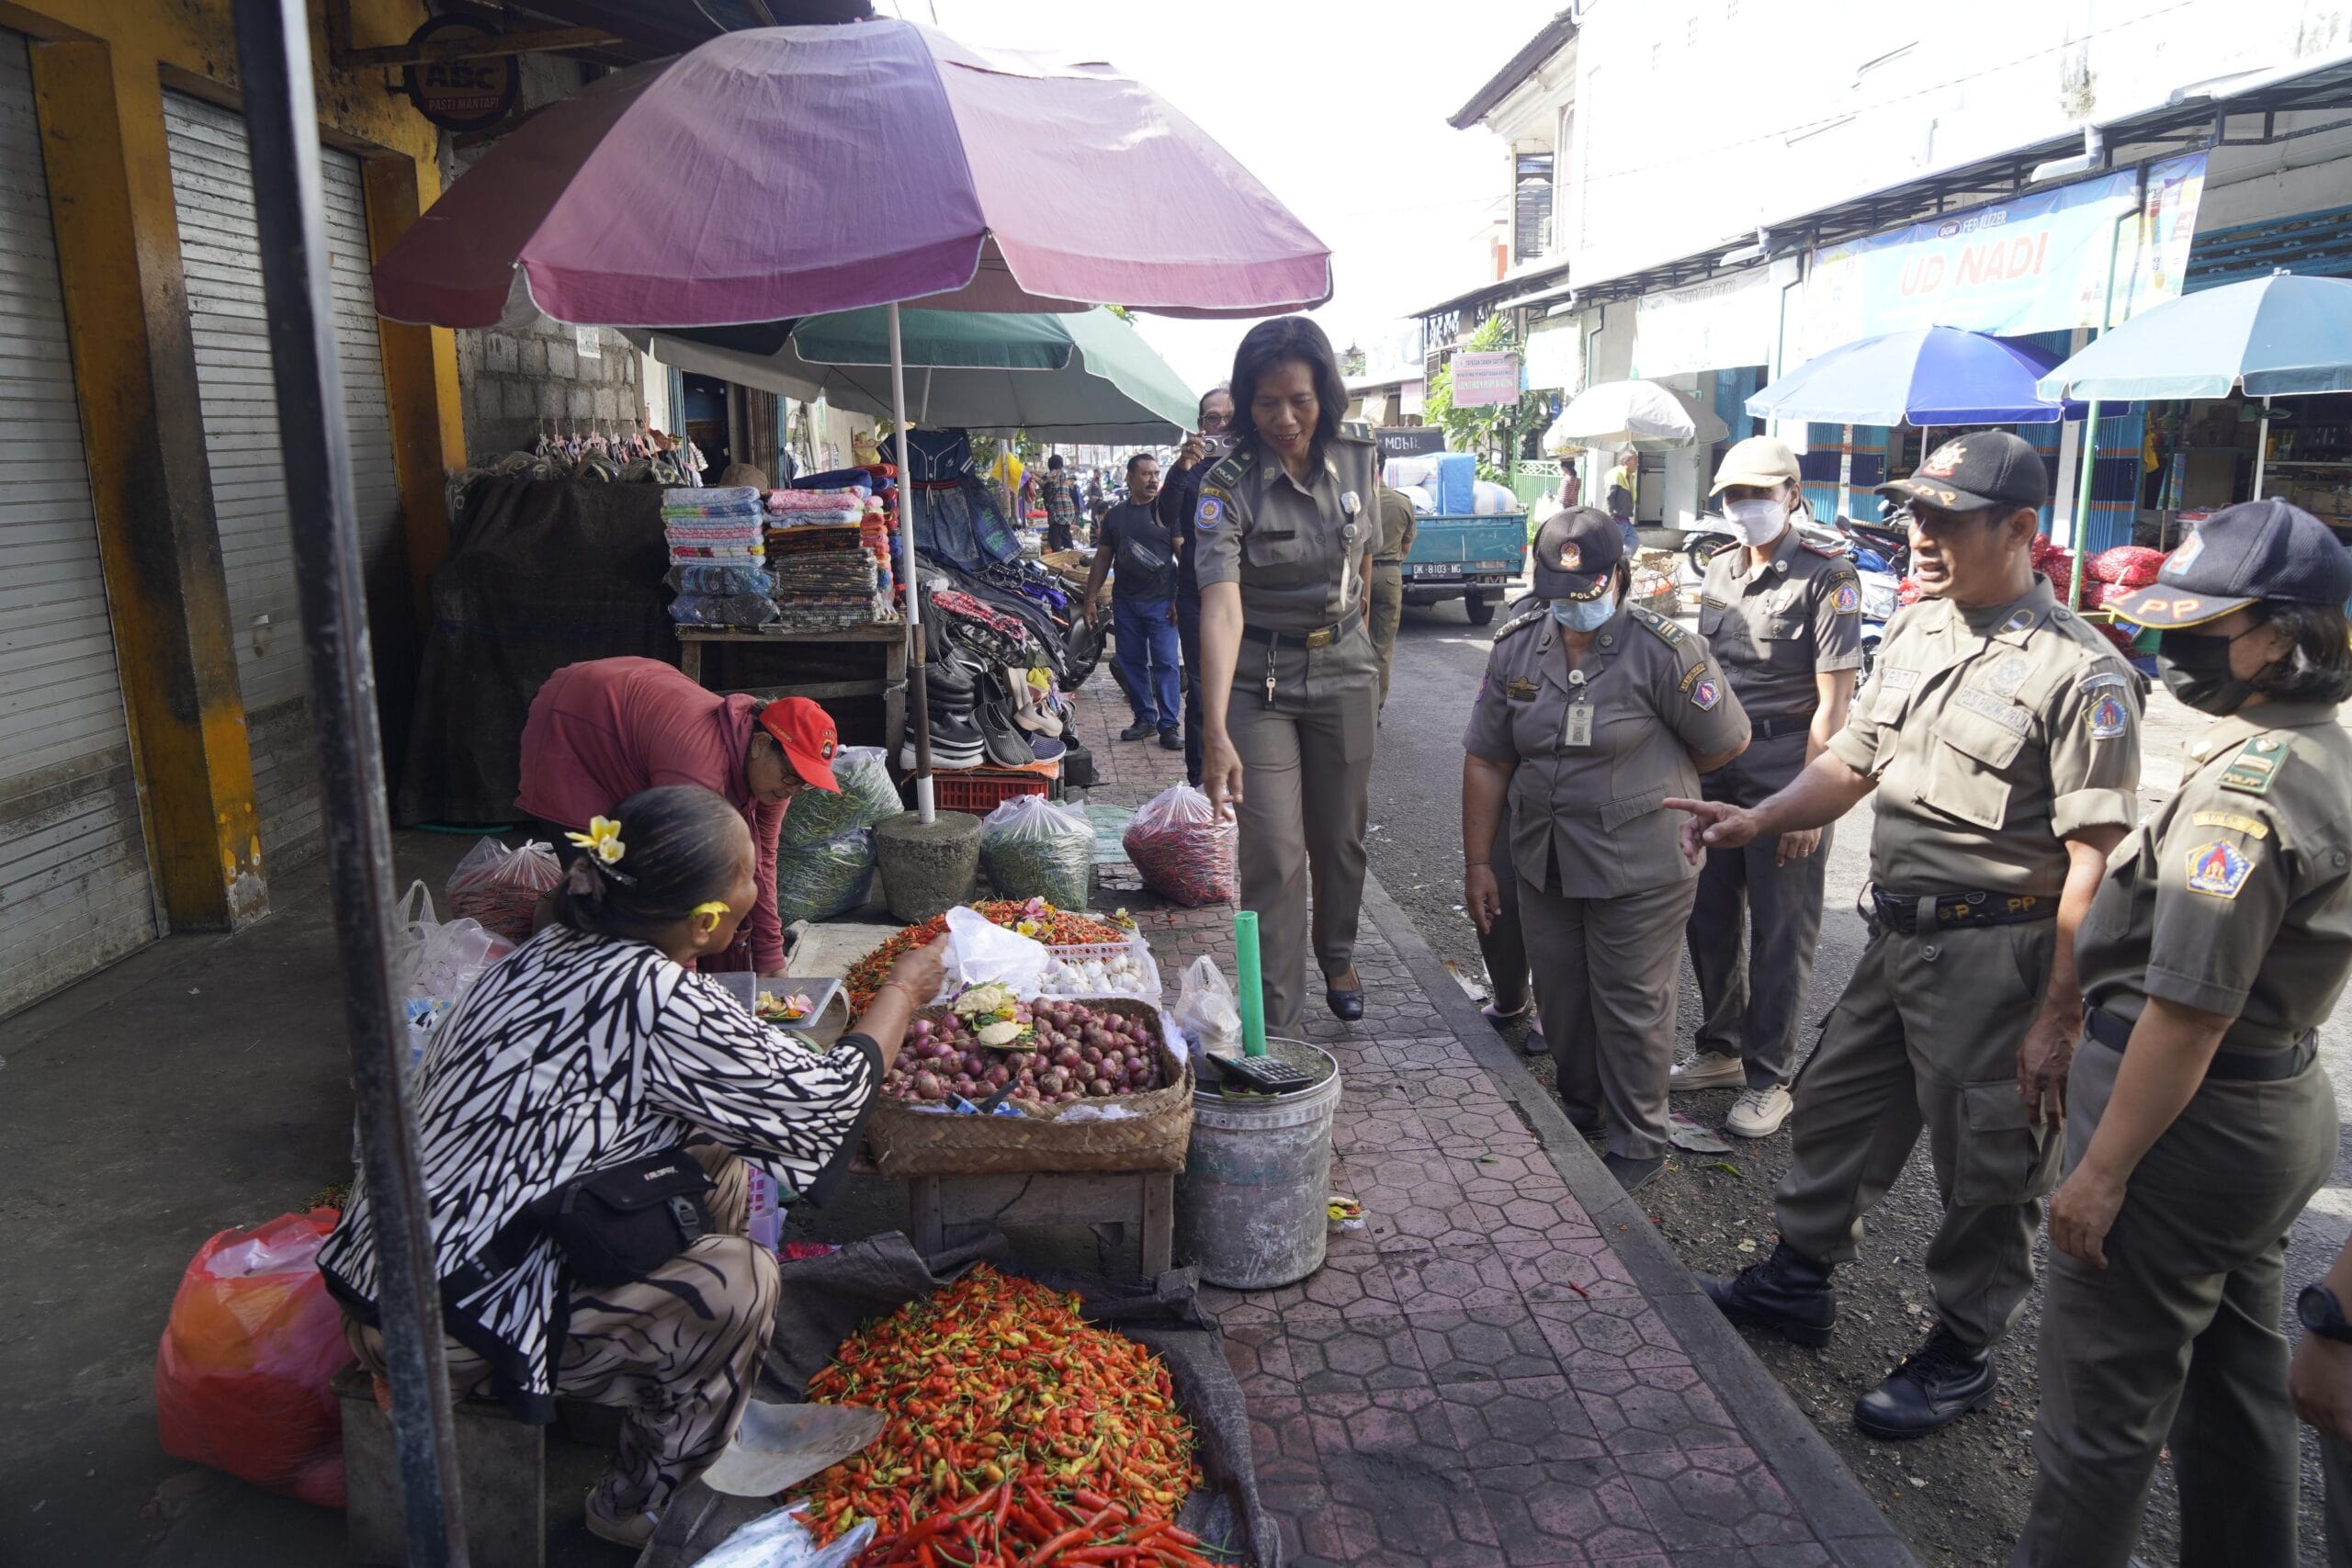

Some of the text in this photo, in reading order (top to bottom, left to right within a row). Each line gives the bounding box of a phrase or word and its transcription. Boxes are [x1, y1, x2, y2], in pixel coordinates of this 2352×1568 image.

[425, 64, 495, 89] ABC
[428, 98, 455, 111] PASTI
[1939, 211, 2007, 237] DGW FERILIZER
[1901, 231, 2049, 296] UD NADI
[1413, 562, 1462, 574] DK 8103 MG
